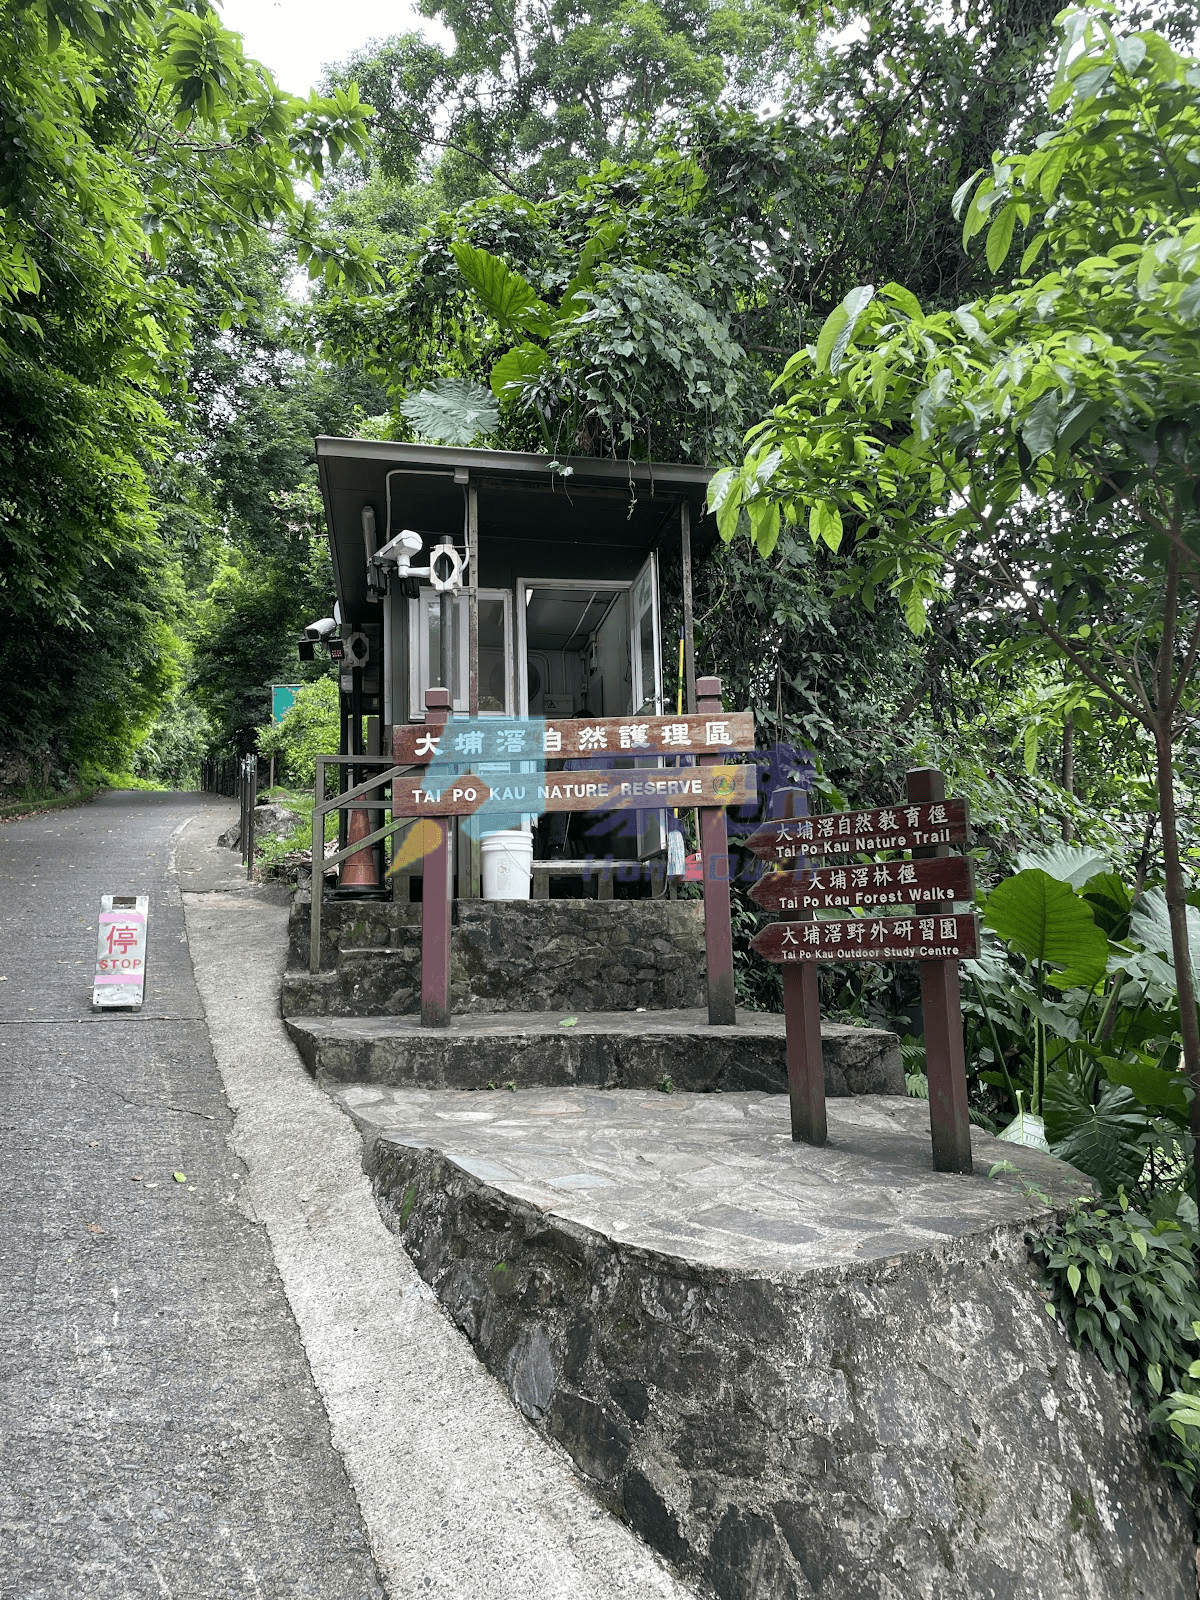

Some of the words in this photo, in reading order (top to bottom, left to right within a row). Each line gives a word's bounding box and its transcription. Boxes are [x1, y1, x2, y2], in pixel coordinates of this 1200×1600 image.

[414, 720, 734, 757] 大埔滘自然護理區
[411, 788, 441, 804] TAI
[452, 787, 478, 803] PO
[489, 786, 527, 802] KAU
[537, 783, 610, 800] NATURE
[620, 779, 703, 797] RESERVE
[775, 804, 949, 843] 大埔滘自然教育徑
[775, 844, 796, 858] Tai
[801, 843, 818, 856] Po
[823, 840, 850, 854] Kau
[856, 835, 907, 851] Nature
[912, 828, 950, 845] Trail
[808, 863, 919, 891] 大埔滘林徑
[779, 896, 798, 909] Tai
[803, 895, 820, 908] Po
[824, 893, 850, 906] Kau
[855, 887, 903, 905] Forest
[908, 886, 955, 901] Walks
[105, 925, 138, 955] 停
[781, 917, 959, 946] 大埔滘野外研習園
[99, 958, 142, 971] STOP
[781, 950, 797, 960] Tai
[799, 949, 812, 959] Po
[815, 949, 834, 959] Kau
[837, 948, 880, 959] Outdoor
[883, 946, 916, 958] Study
[919, 945, 960, 956] Centre
